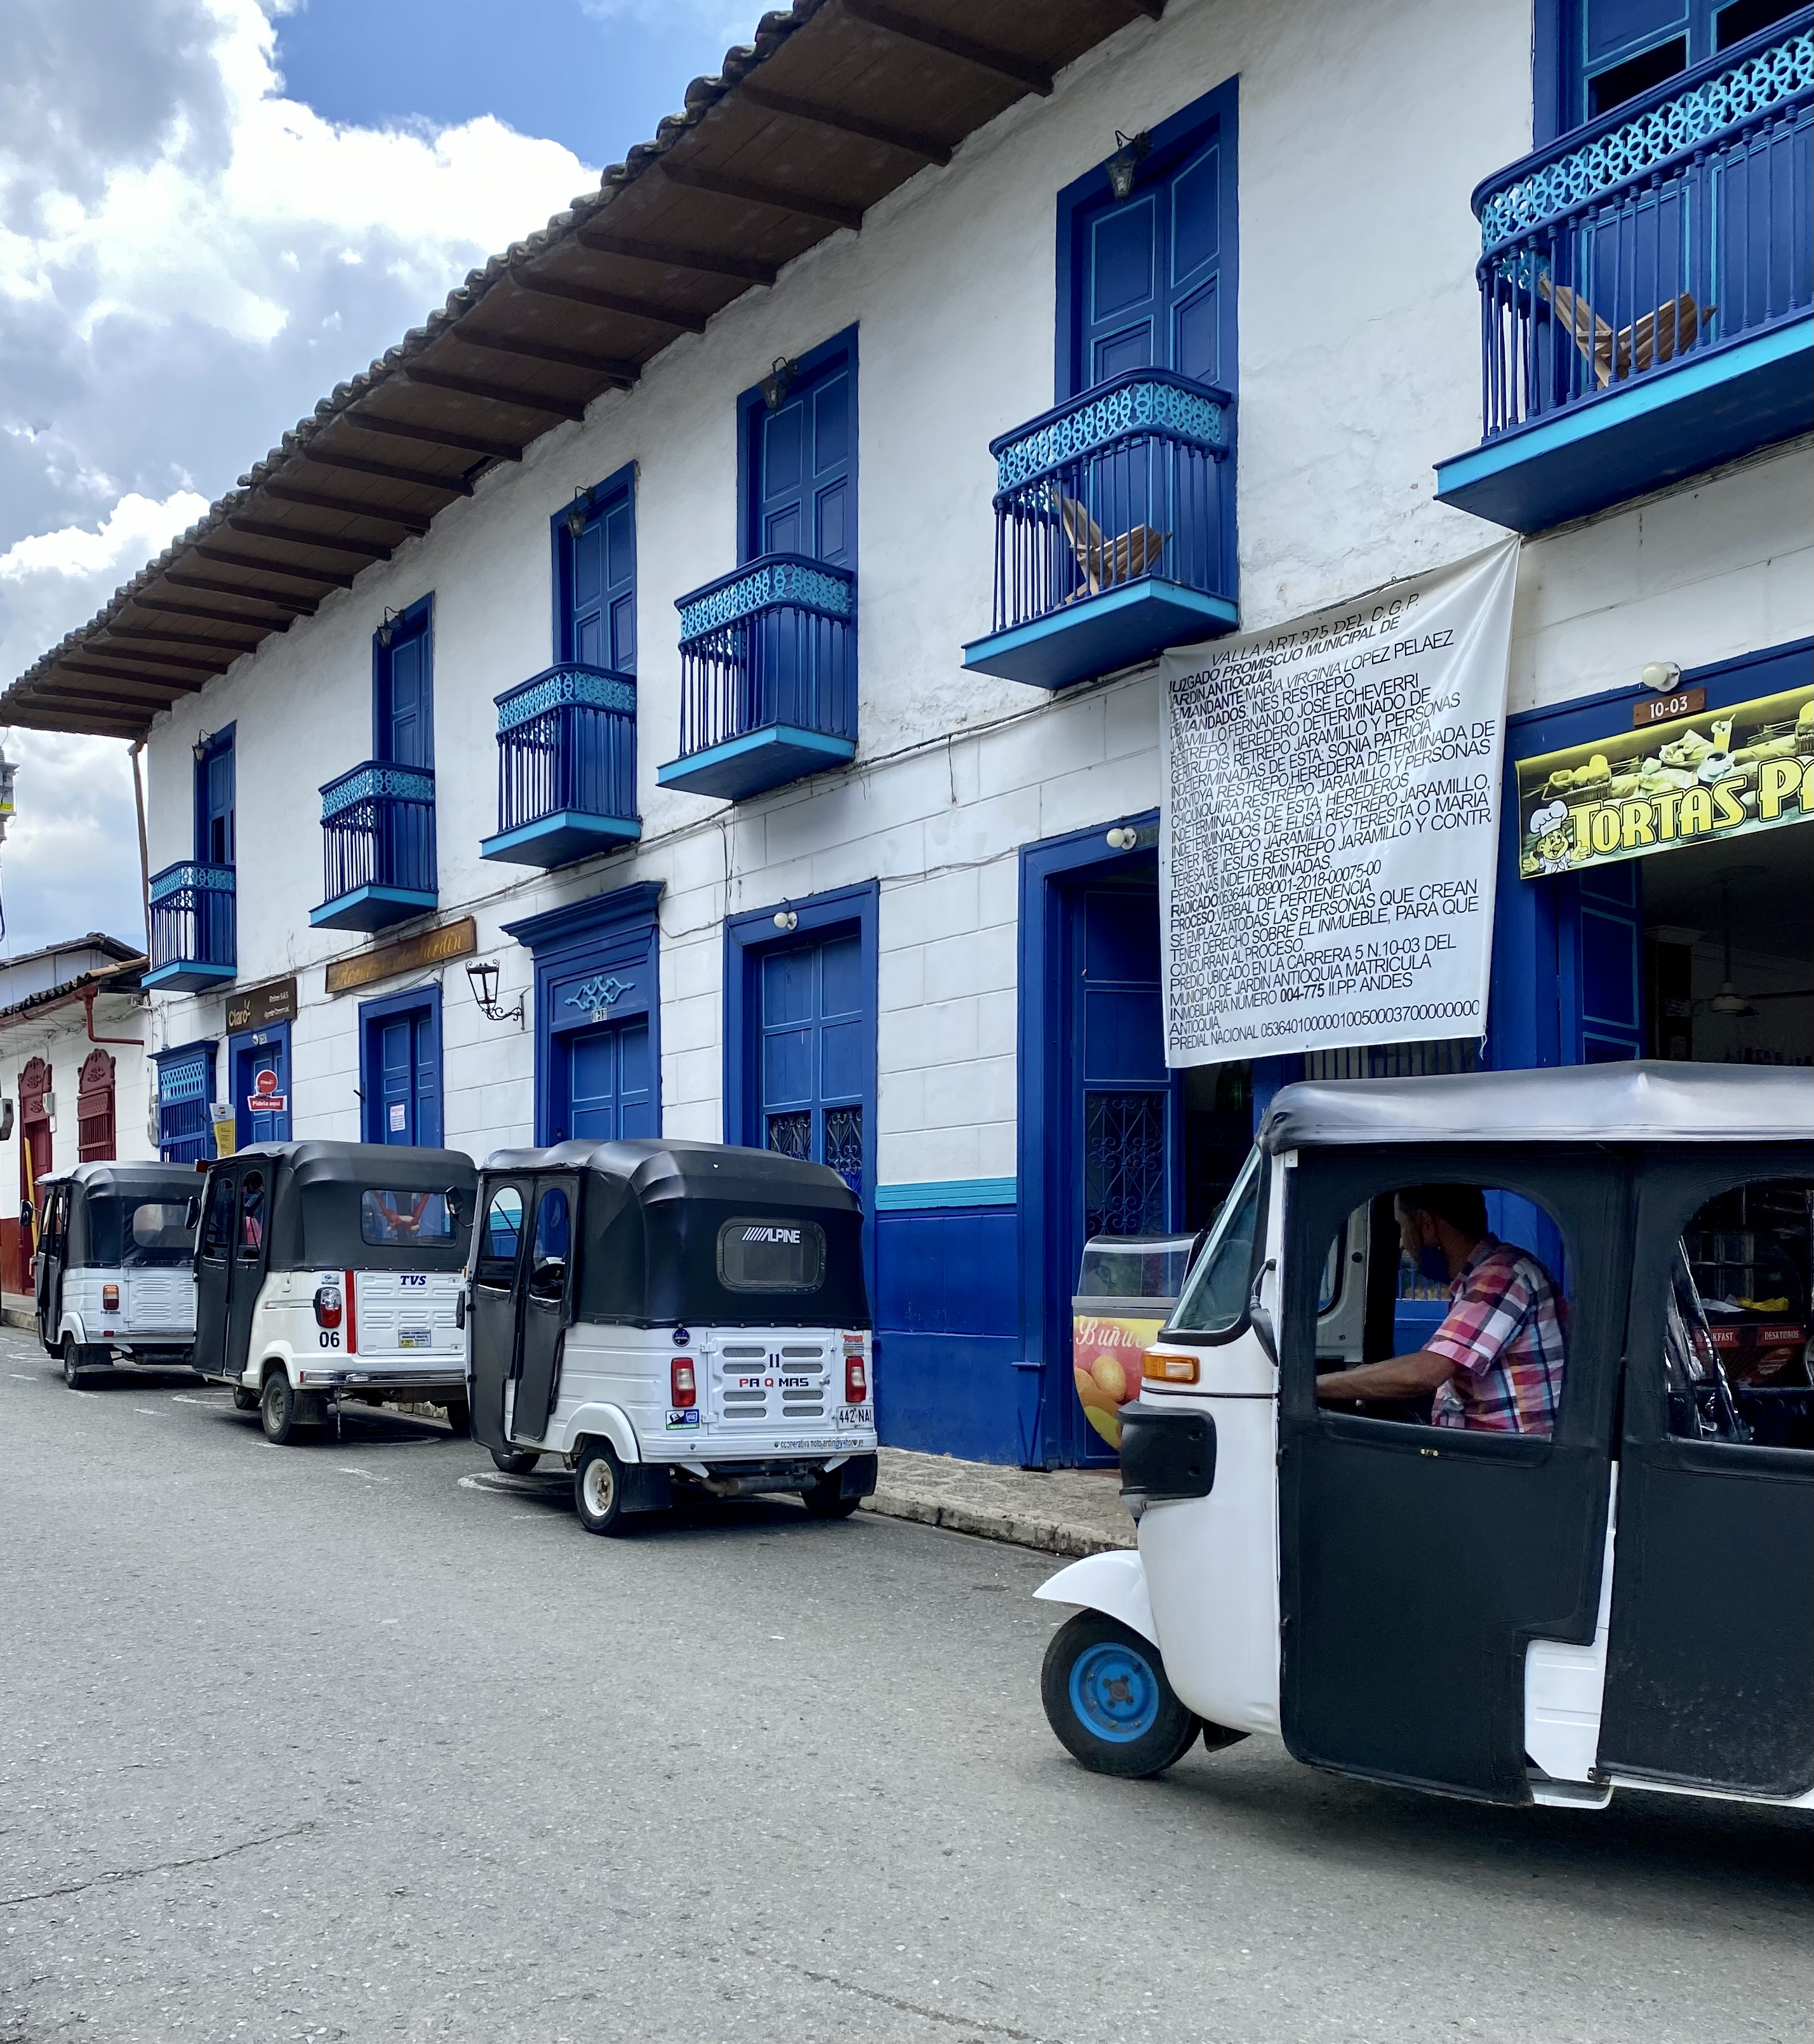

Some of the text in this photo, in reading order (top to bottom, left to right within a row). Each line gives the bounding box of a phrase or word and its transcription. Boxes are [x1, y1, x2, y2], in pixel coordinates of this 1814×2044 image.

[1169, 616, 1401, 694] JUZGADO PROMISCUO MUNICIPAL DE
[1213, 594, 1419, 666] VALLA ART.375 DEL C.G.P.
[1288, 662, 1341, 688] VIRGINIA
[1344, 646, 1391, 672] LOPEZ
[1394, 629, 1454, 658] PELAEZ
[1170, 673, 1354, 740] DEMANDADOS: INES RESTREPO
[1297, 695, 1331, 718] JOSE
[1336, 673, 1418, 708] ECHEVERRI
[1650, 696, 1688, 719] 10-03
[1171, 686, 1431, 770] RESTREPO, HEREDERO DETERMINADO DE
[1171, 692, 1460, 784] GERTRUDIS RETREPO JARAMILLO Y PERSONAS
[1171, 762, 1265, 799] INDETERMINADAS
[1269, 757, 1286, 774] DE
[1328, 736, 1371, 759] SONIA
[1375, 719, 1431, 748] PATRICIA
[1171, 787, 1213, 814] MONTOYA
[1368, 725, 1467, 766] DETERMINADA
[1472, 720, 1495, 739] DE
[1243, 782, 1314, 809] RESTREPO
[1317, 763, 1390, 793] JARAMILLO
[1394, 758, 1403, 774] Y
[1404, 739, 1490, 771] PERSONAS
[1171, 809, 1260, 844] INDETERMINADAS
[1264, 804, 1283, 820] DE
[1326, 773, 1409, 807] HEREDEROS
[1171, 774, 1490, 859] INDETERMINADOS DE ELISA RESTREPO JARAMILLO,
[1171, 791, 1489, 873] ESTER RESTREPO JARAMILLO Y TERESITA O MARIA
[1567, 774, 1748, 856] TORTAS
[1171, 808, 1492, 889] TERESA DE JESUS RESTREPO JARAMILLO Y CONTR
[1171, 855, 1333, 903] PERSONAS INDETERMINADAS.
[1258, 896, 1276, 912] DE
[1280, 878, 1371, 908] PERTENENCIA
[1170, 896, 1479, 962] TENER DERECHO SOBRE EL INMUEBLE, PARA QUE
[1171, 932, 1185, 948] SE
[1274, 908, 1298, 925] LAS
[1302, 893, 1375, 920] PERSONAS
[1380, 886, 1415, 906] QUE
[1419, 879, 1477, 901] CREAN
[1170, 938, 1305, 977] CONCURRAN AL PROCESO.
[1170, 973, 1204, 992] PREDIO
[1207, 964, 1250, 985] UBICADO
[1253, 960, 1267, 976] EN
[1270, 957, 1284, 972] LA
[1287, 946, 1352, 969] CARRERA
[1355, 945, 1363, 959] 5
[1425, 933, 1457, 952] DEL
[1170, 953, 1432, 1007] MUNICIPIO DE JARDIN ANTIOQUIA MATRICULA
[229, 1009, 248, 1027] Claro
[1170, 999, 1229, 1021] INMOBILIARIA
[1280, 983, 1324, 1002] 004-775
[1359, 972, 1413, 992] ANDES
[1170, 1033, 1209, 1051] PREDIAL
[1211, 1025, 1258, 1044] NACIONAL
[400, 1275, 427, 1285] TVS
[319, 1331, 340, 1348] 06
[769, 1353, 780, 1368] 11
[1764, 1331, 1799, 1341] DESAYUNOS
[739, 1377, 810, 1388] PA Q MAS
[839, 1409, 855, 1423] 442
